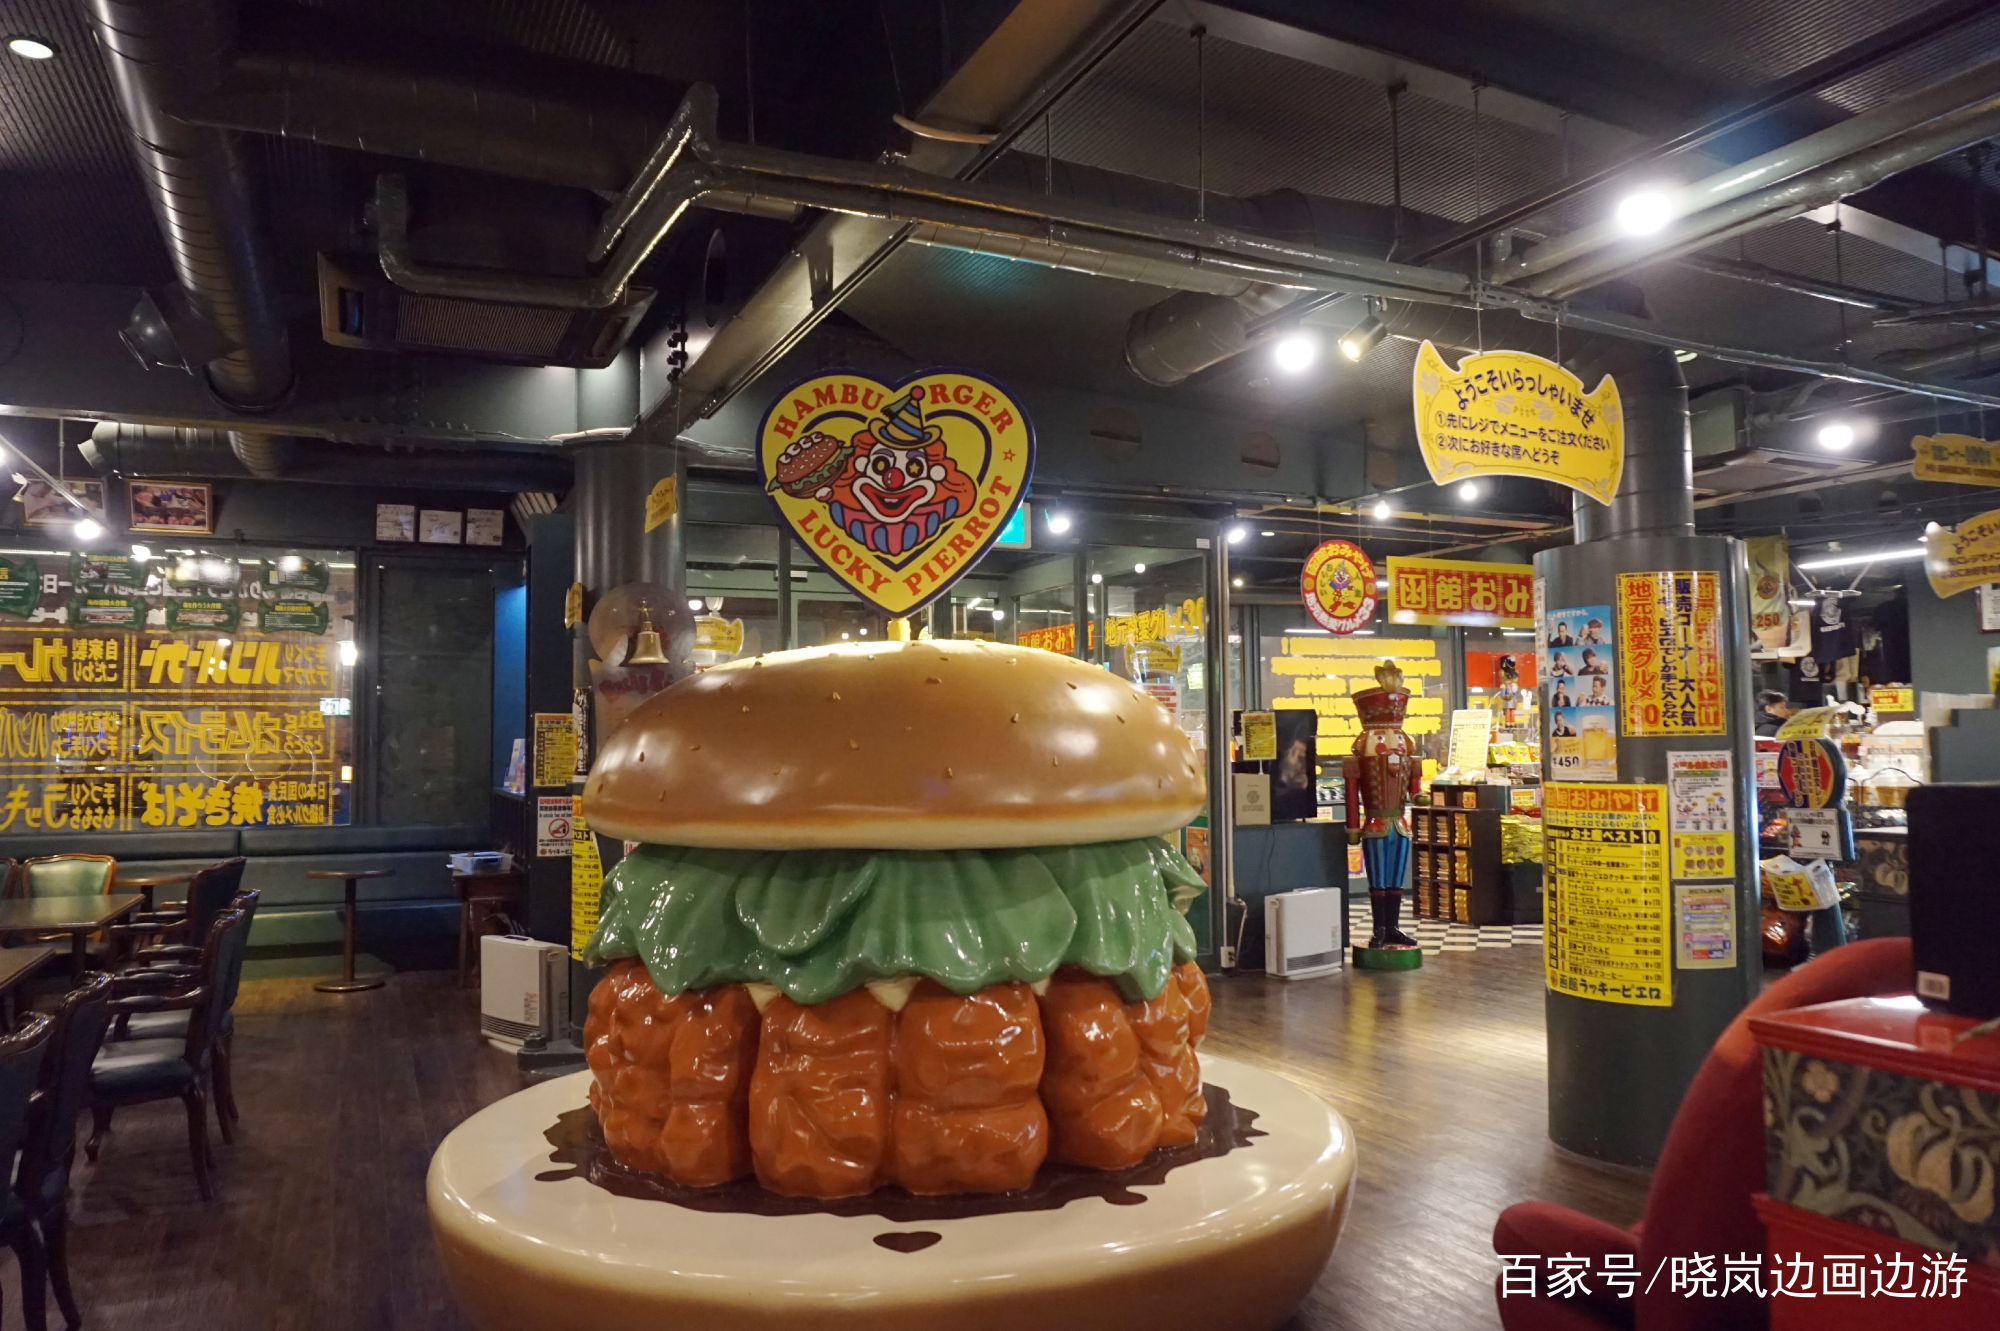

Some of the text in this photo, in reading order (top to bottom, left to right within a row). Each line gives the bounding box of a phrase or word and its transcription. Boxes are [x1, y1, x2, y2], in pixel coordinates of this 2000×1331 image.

[1453, 367, 1596, 429] ようこそいらっしゃいませ
[1435, 410, 1610, 451] ①先にレジでメニューをご注文ください
[1435, 433, 1561, 466] ②次にお好きな席へどうぞ
[798, 475, 1012, 596] LUCKY PIERROT
[1399, 573, 1530, 613] 函館おみ
[1674, 578, 1697, 727] 販売コーナー大人気
[1559, 973, 1661, 1000] 函館ラッキーピエロ
